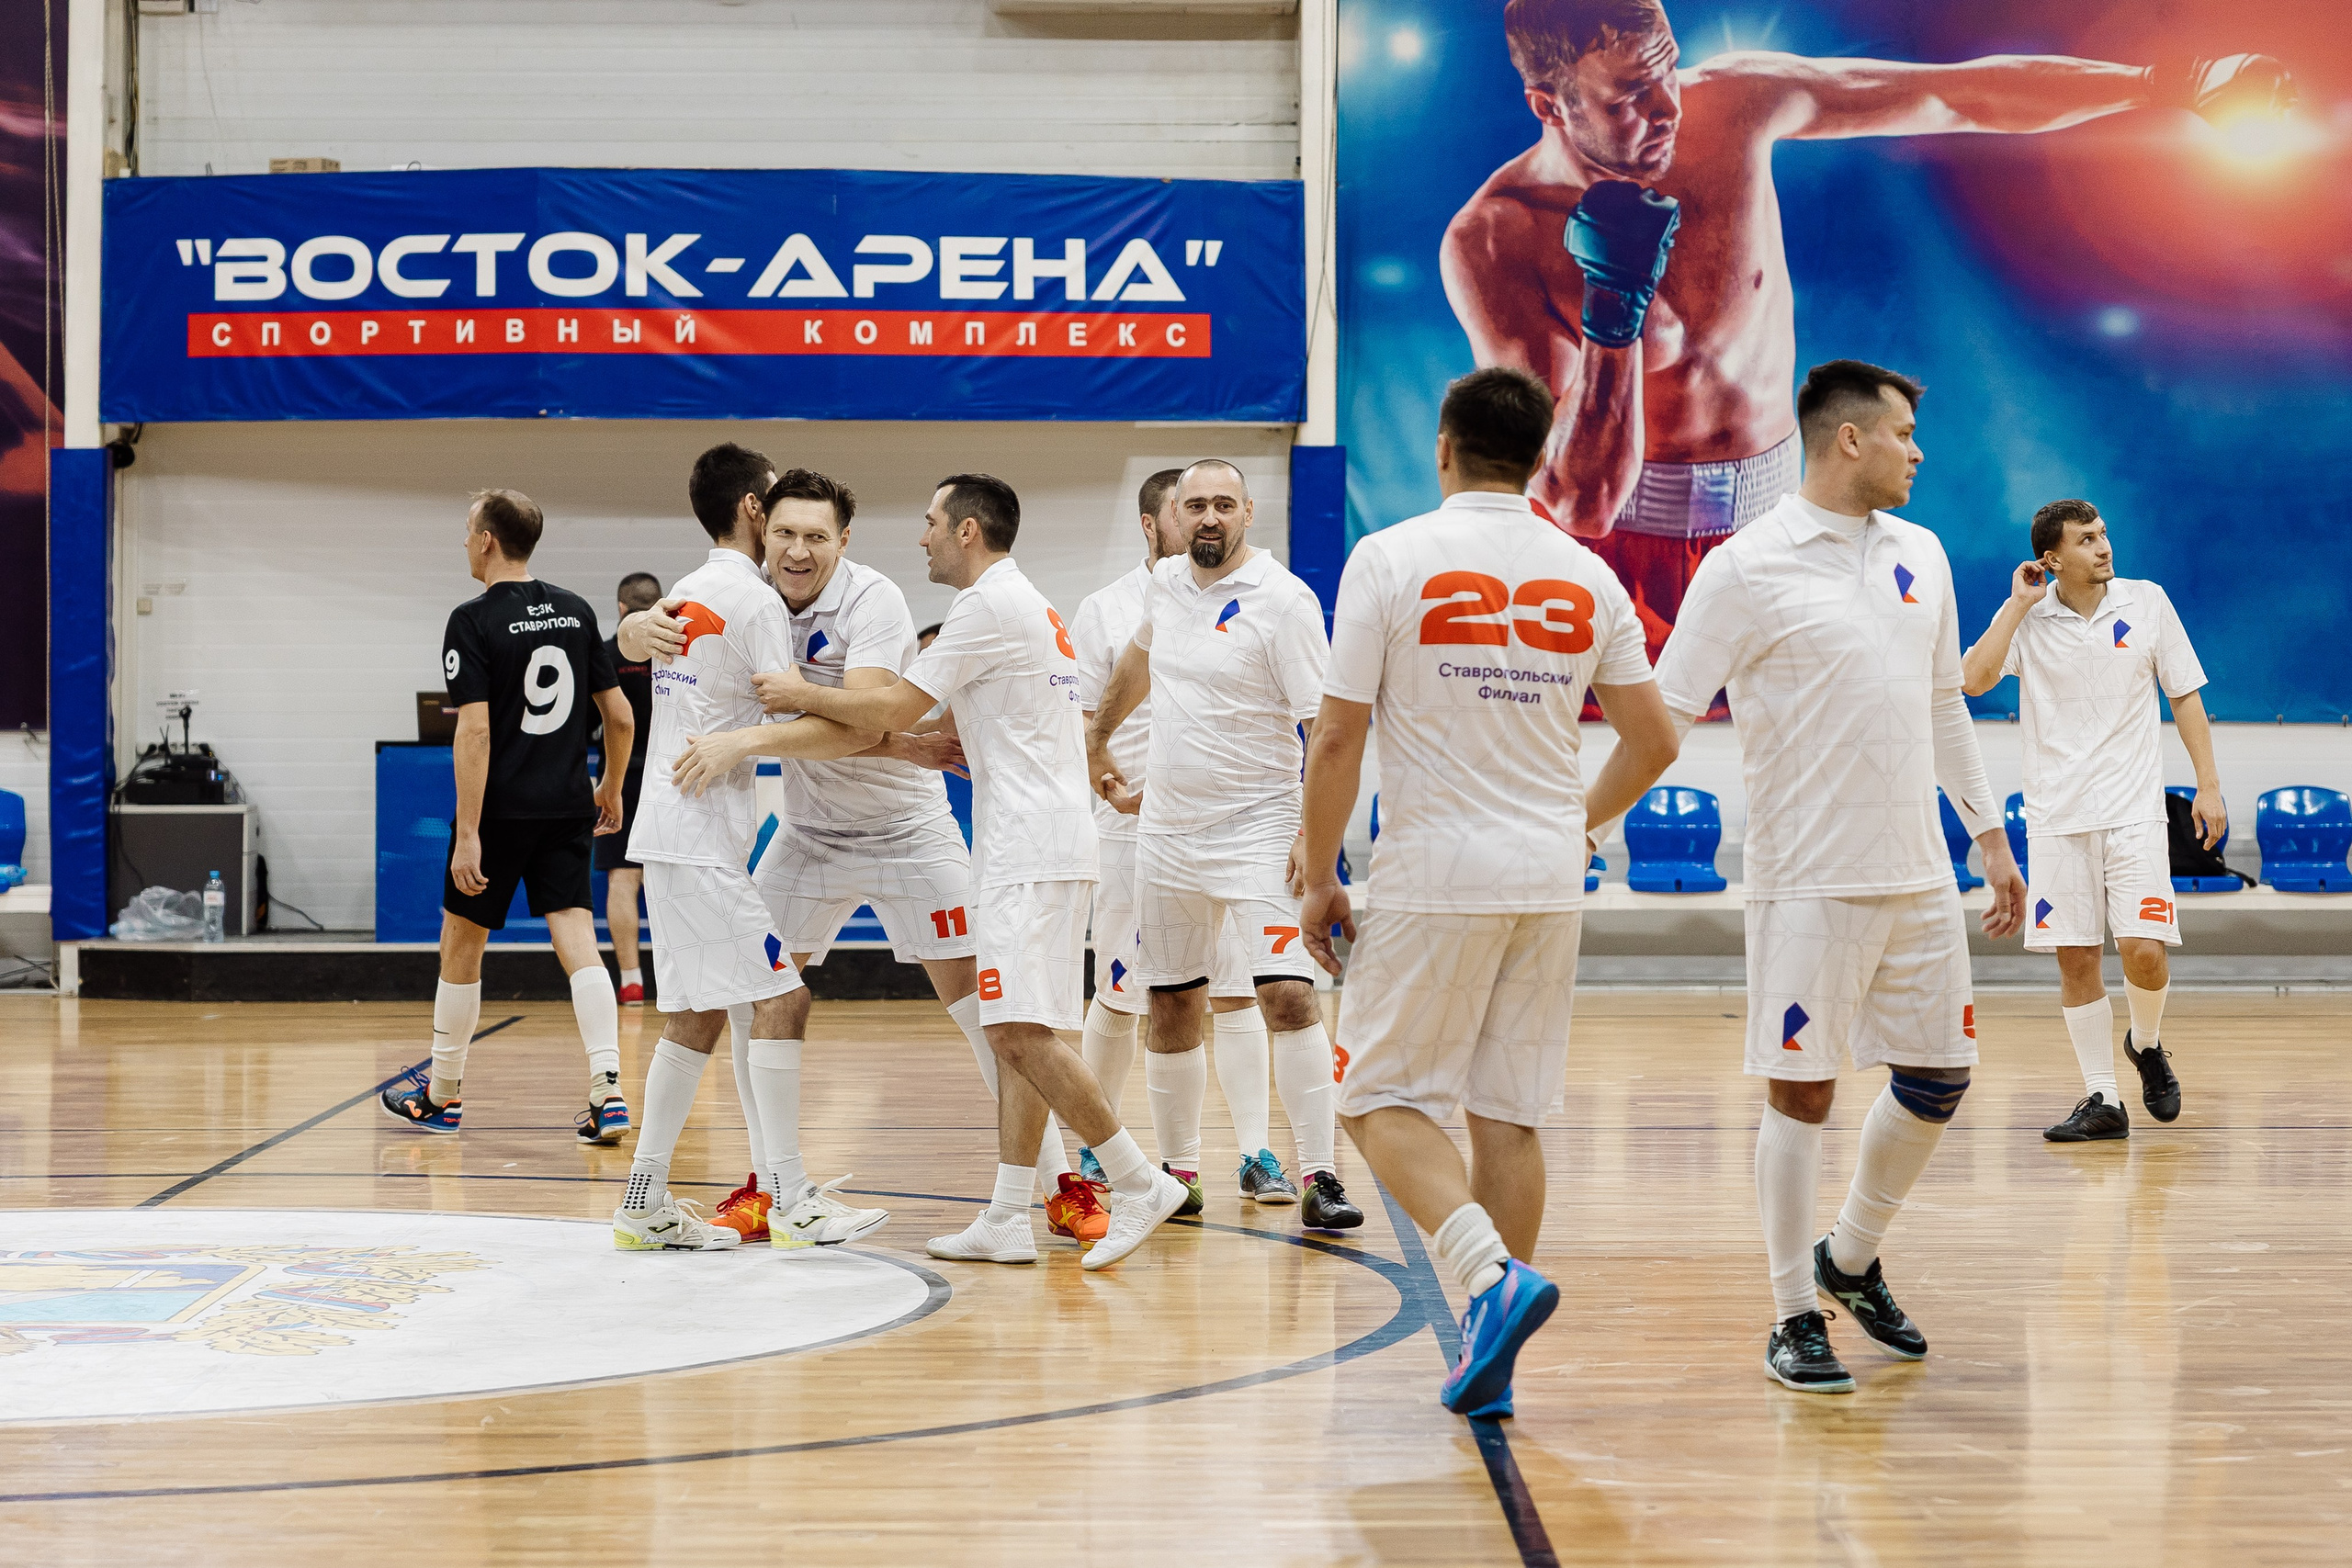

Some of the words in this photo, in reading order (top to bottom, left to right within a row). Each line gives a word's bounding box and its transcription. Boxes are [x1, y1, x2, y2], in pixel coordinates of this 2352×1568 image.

[211, 313, 696, 347] СПОРТИВНЫЙ
[804, 318, 1186, 347] КОМПЛЕКС
[507, 616, 581, 634] СТАВРОПОЛЬ
[1419, 570, 1595, 654] 23
[445, 649, 459, 680] 9
[520, 645, 574, 735] 9
[930, 906, 967, 939] 11
[2139, 897, 2174, 925] 21
[1263, 926, 1299, 954] 7
[978, 967, 1003, 1001] 8
